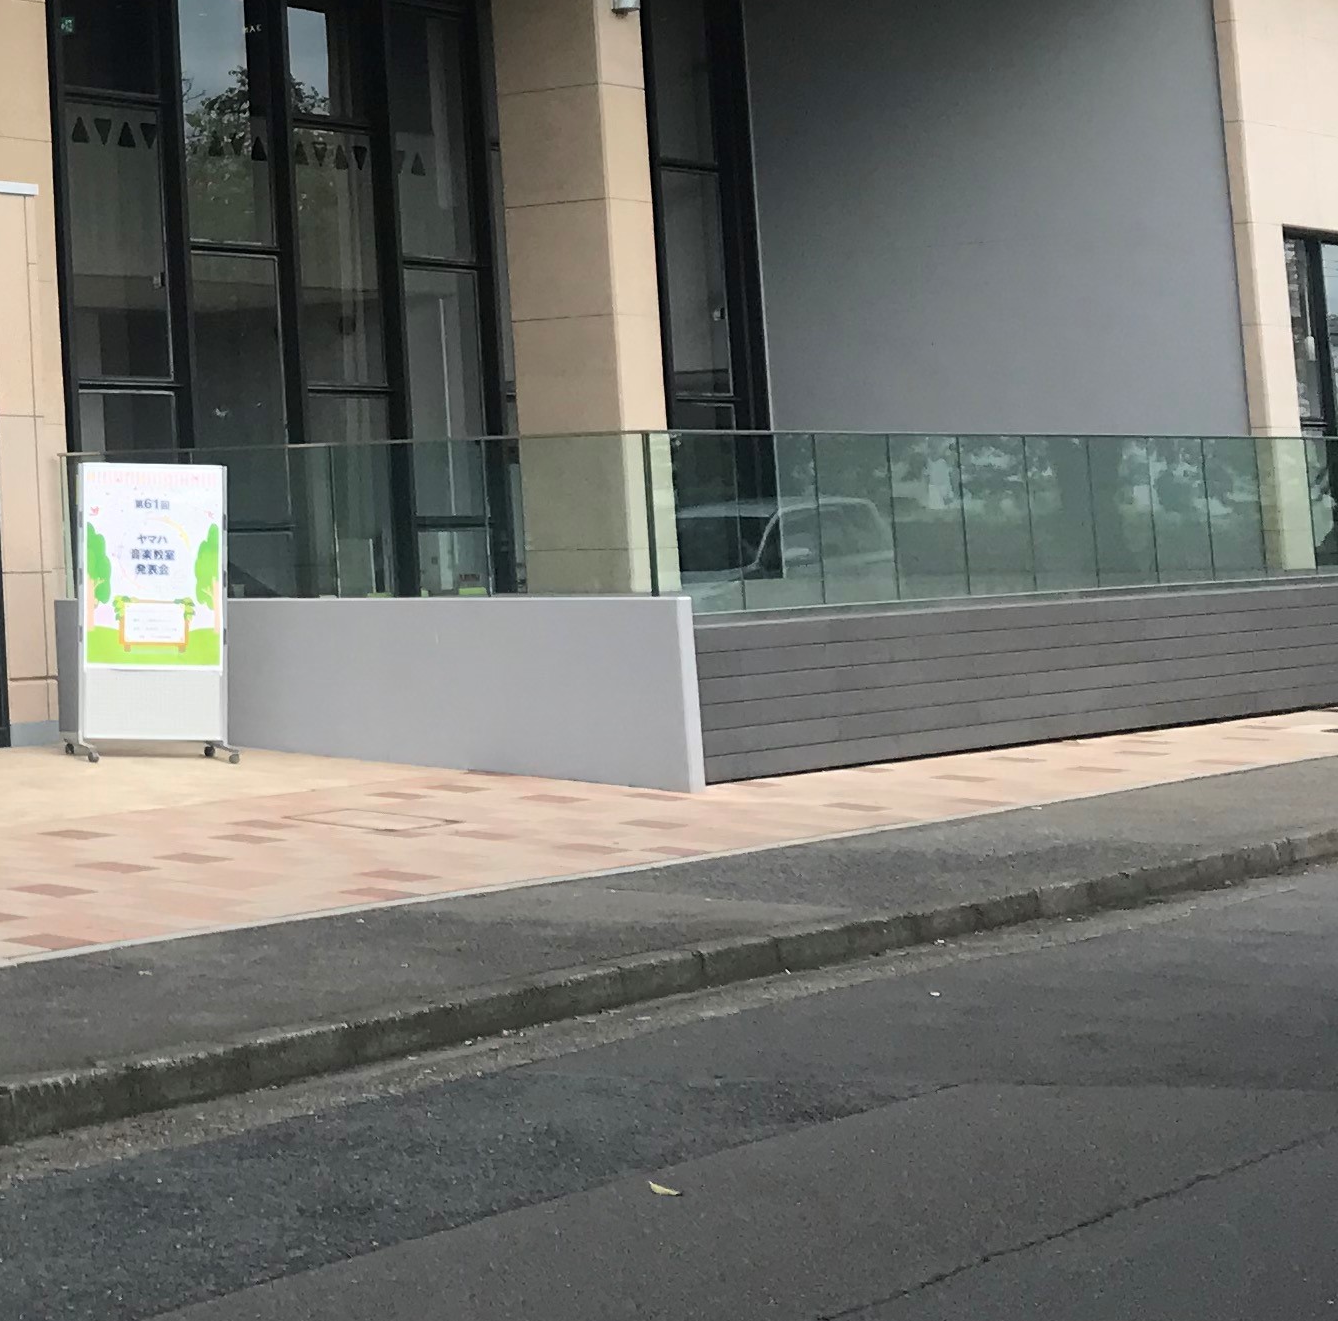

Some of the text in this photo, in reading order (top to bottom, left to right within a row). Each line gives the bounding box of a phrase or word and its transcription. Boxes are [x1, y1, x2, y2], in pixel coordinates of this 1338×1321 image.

[137, 533, 168, 544] ヤマハ
[131, 548, 175, 560] 音楽教室
[135, 563, 170, 575] 発表会
